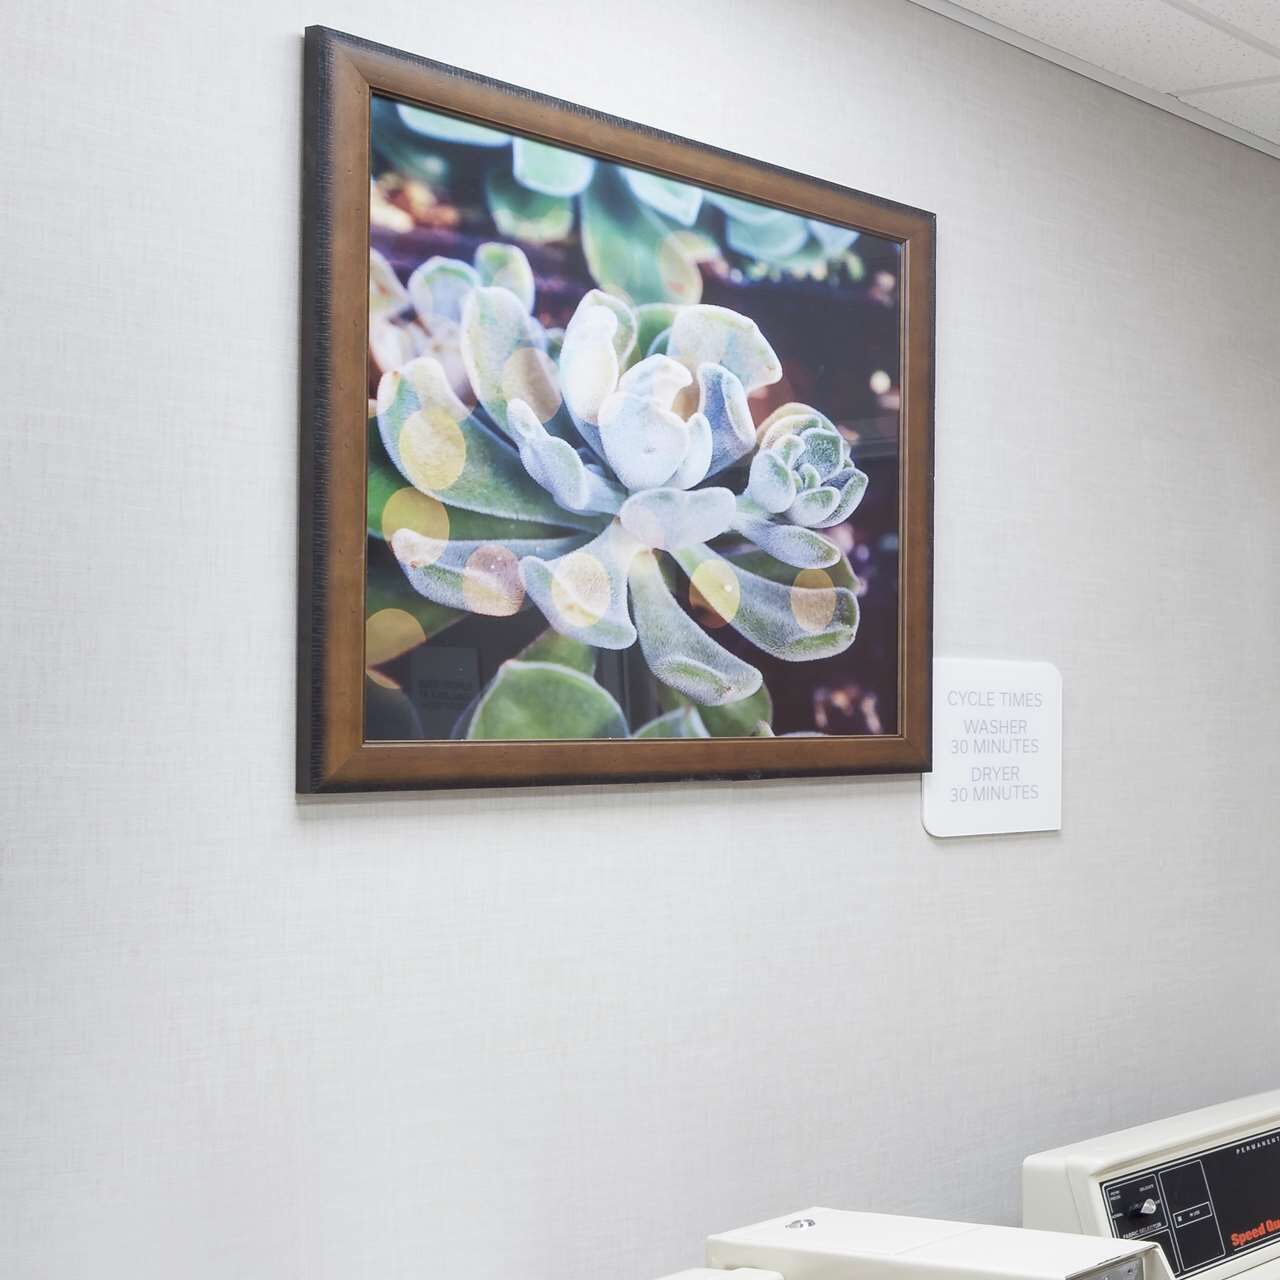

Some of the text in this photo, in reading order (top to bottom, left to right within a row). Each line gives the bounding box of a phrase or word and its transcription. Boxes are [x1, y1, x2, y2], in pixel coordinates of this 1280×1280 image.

[947, 690, 1043, 708] CYCLE TIMES
[963, 719, 1028, 735] WASHER
[951, 738, 1040, 755] 30 MINUTES
[971, 766, 1020, 782] DRYER
[950, 785, 1039, 802] 30 MINUTES
[1230, 1221, 1266, 1247] Speed
